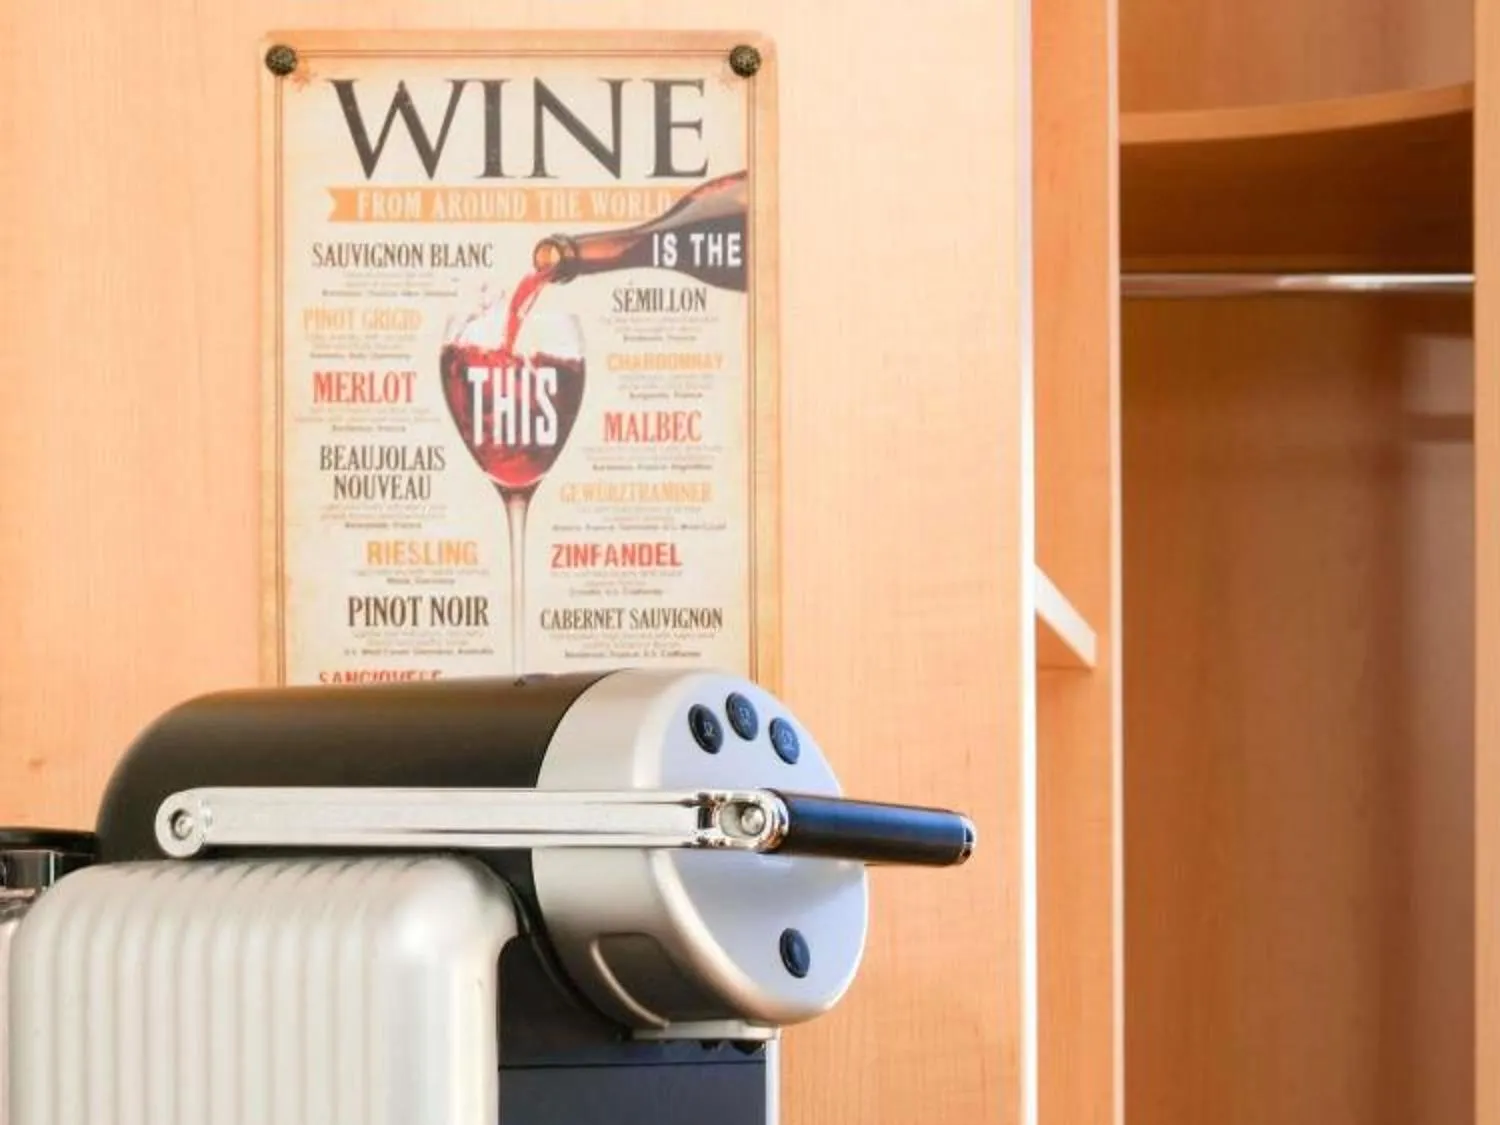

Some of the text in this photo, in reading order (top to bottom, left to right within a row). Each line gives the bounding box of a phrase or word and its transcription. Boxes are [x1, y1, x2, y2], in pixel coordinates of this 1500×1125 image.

[329, 77, 709, 180] WINE
[356, 191, 670, 220] FROM AROUND THE WORLD
[311, 243, 494, 268] SAUVIGNON BLANC
[652, 233, 742, 268] IS THE
[302, 308, 354, 332] PINOT
[606, 352, 724, 371] CHARDONNAY
[312, 370, 417, 404] MERLOT
[467, 366, 558, 447] THIS
[603, 410, 703, 443] MALBEC
[319, 445, 447, 471] BEAUJOLAIS
[333, 474, 432, 500] NOUVEAU
[366, 540, 479, 567] RIESLING
[550, 542, 683, 569] ZINFANDEL
[347, 595, 490, 627] PINOT NOIR
[540, 607, 724, 631] CABERNET SAUVIGNON
